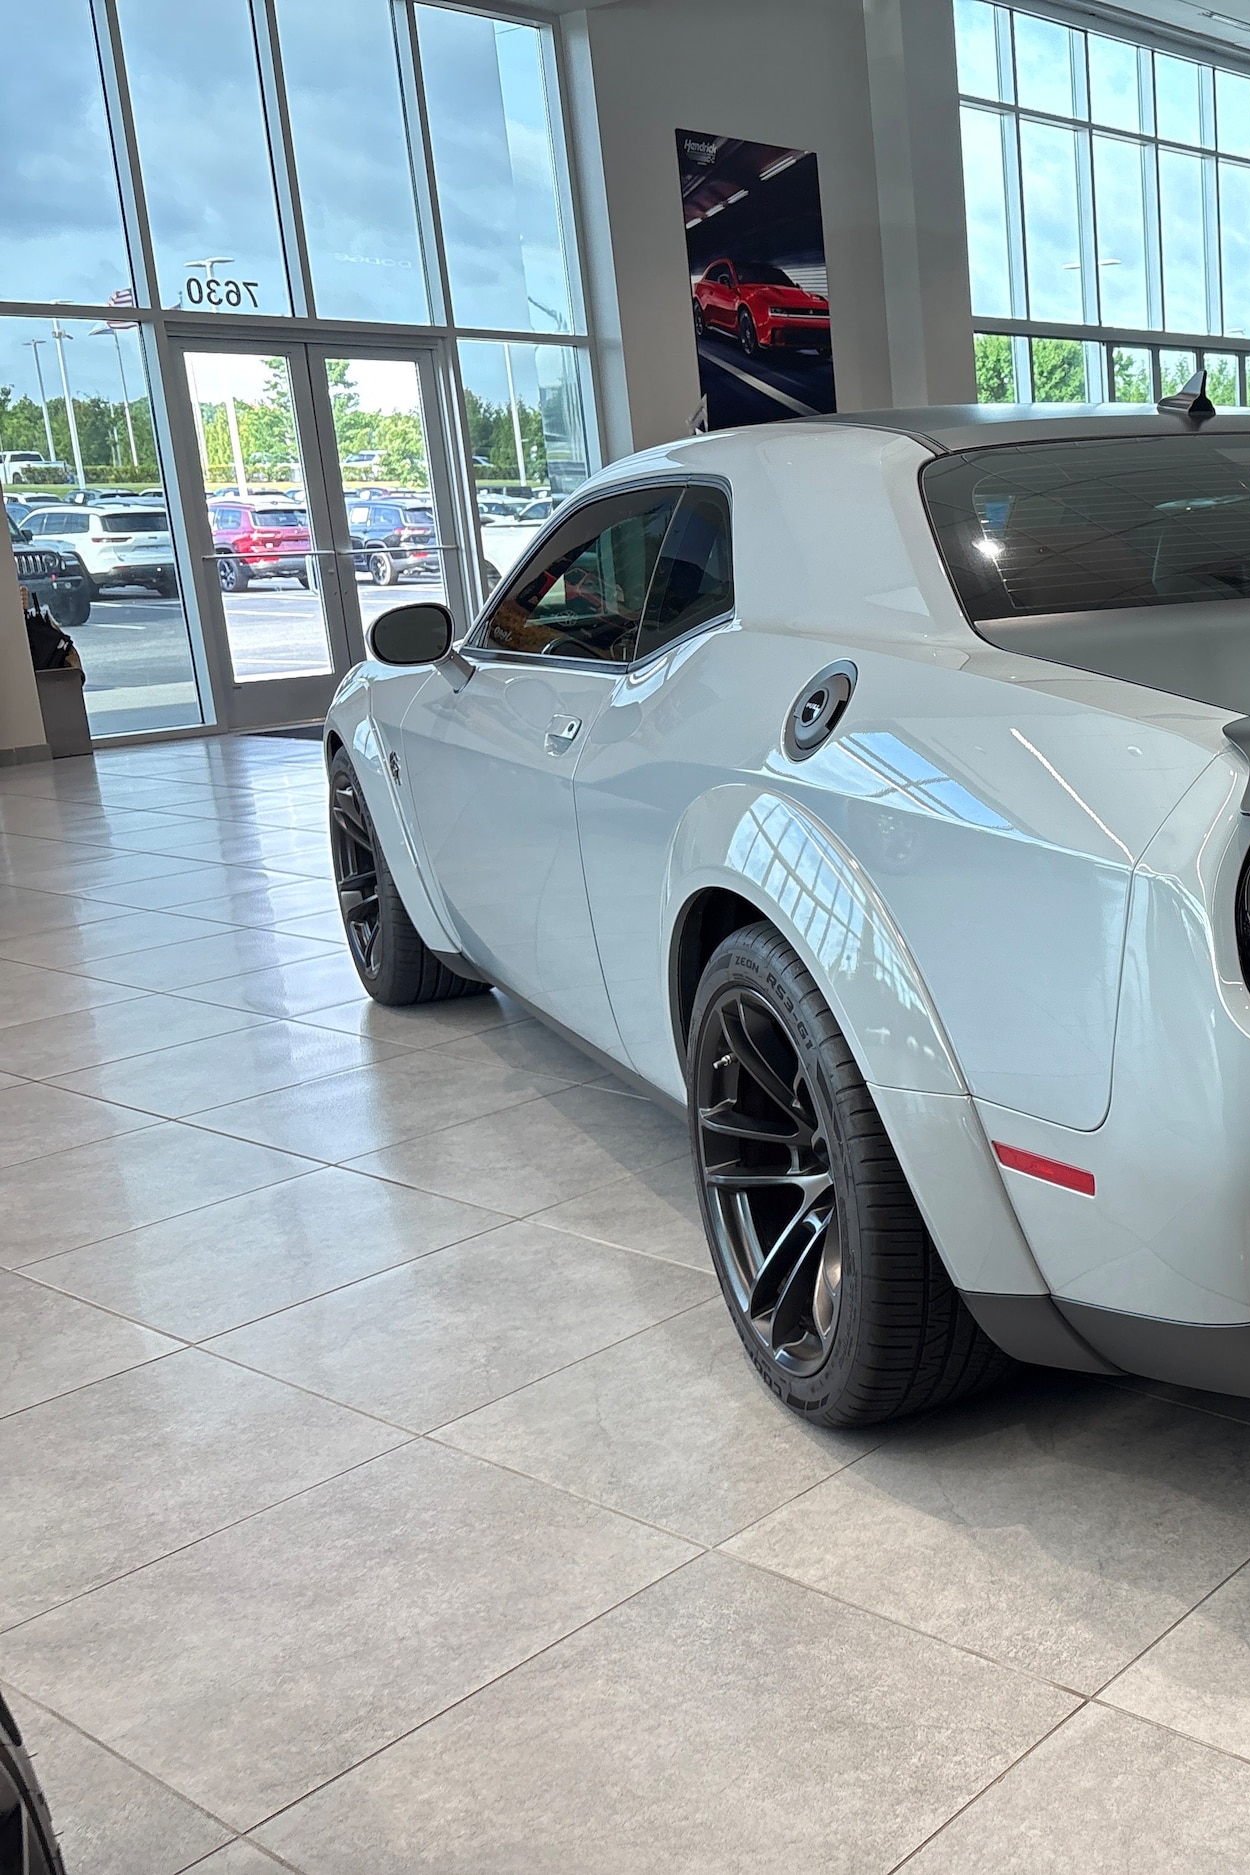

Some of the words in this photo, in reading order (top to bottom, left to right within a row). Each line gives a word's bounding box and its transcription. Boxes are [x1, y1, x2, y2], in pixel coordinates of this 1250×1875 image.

[684, 139, 717, 154] Hendrick
[735, 956, 760, 973] ZEON
[766, 972, 814, 1050] RS3-G1
